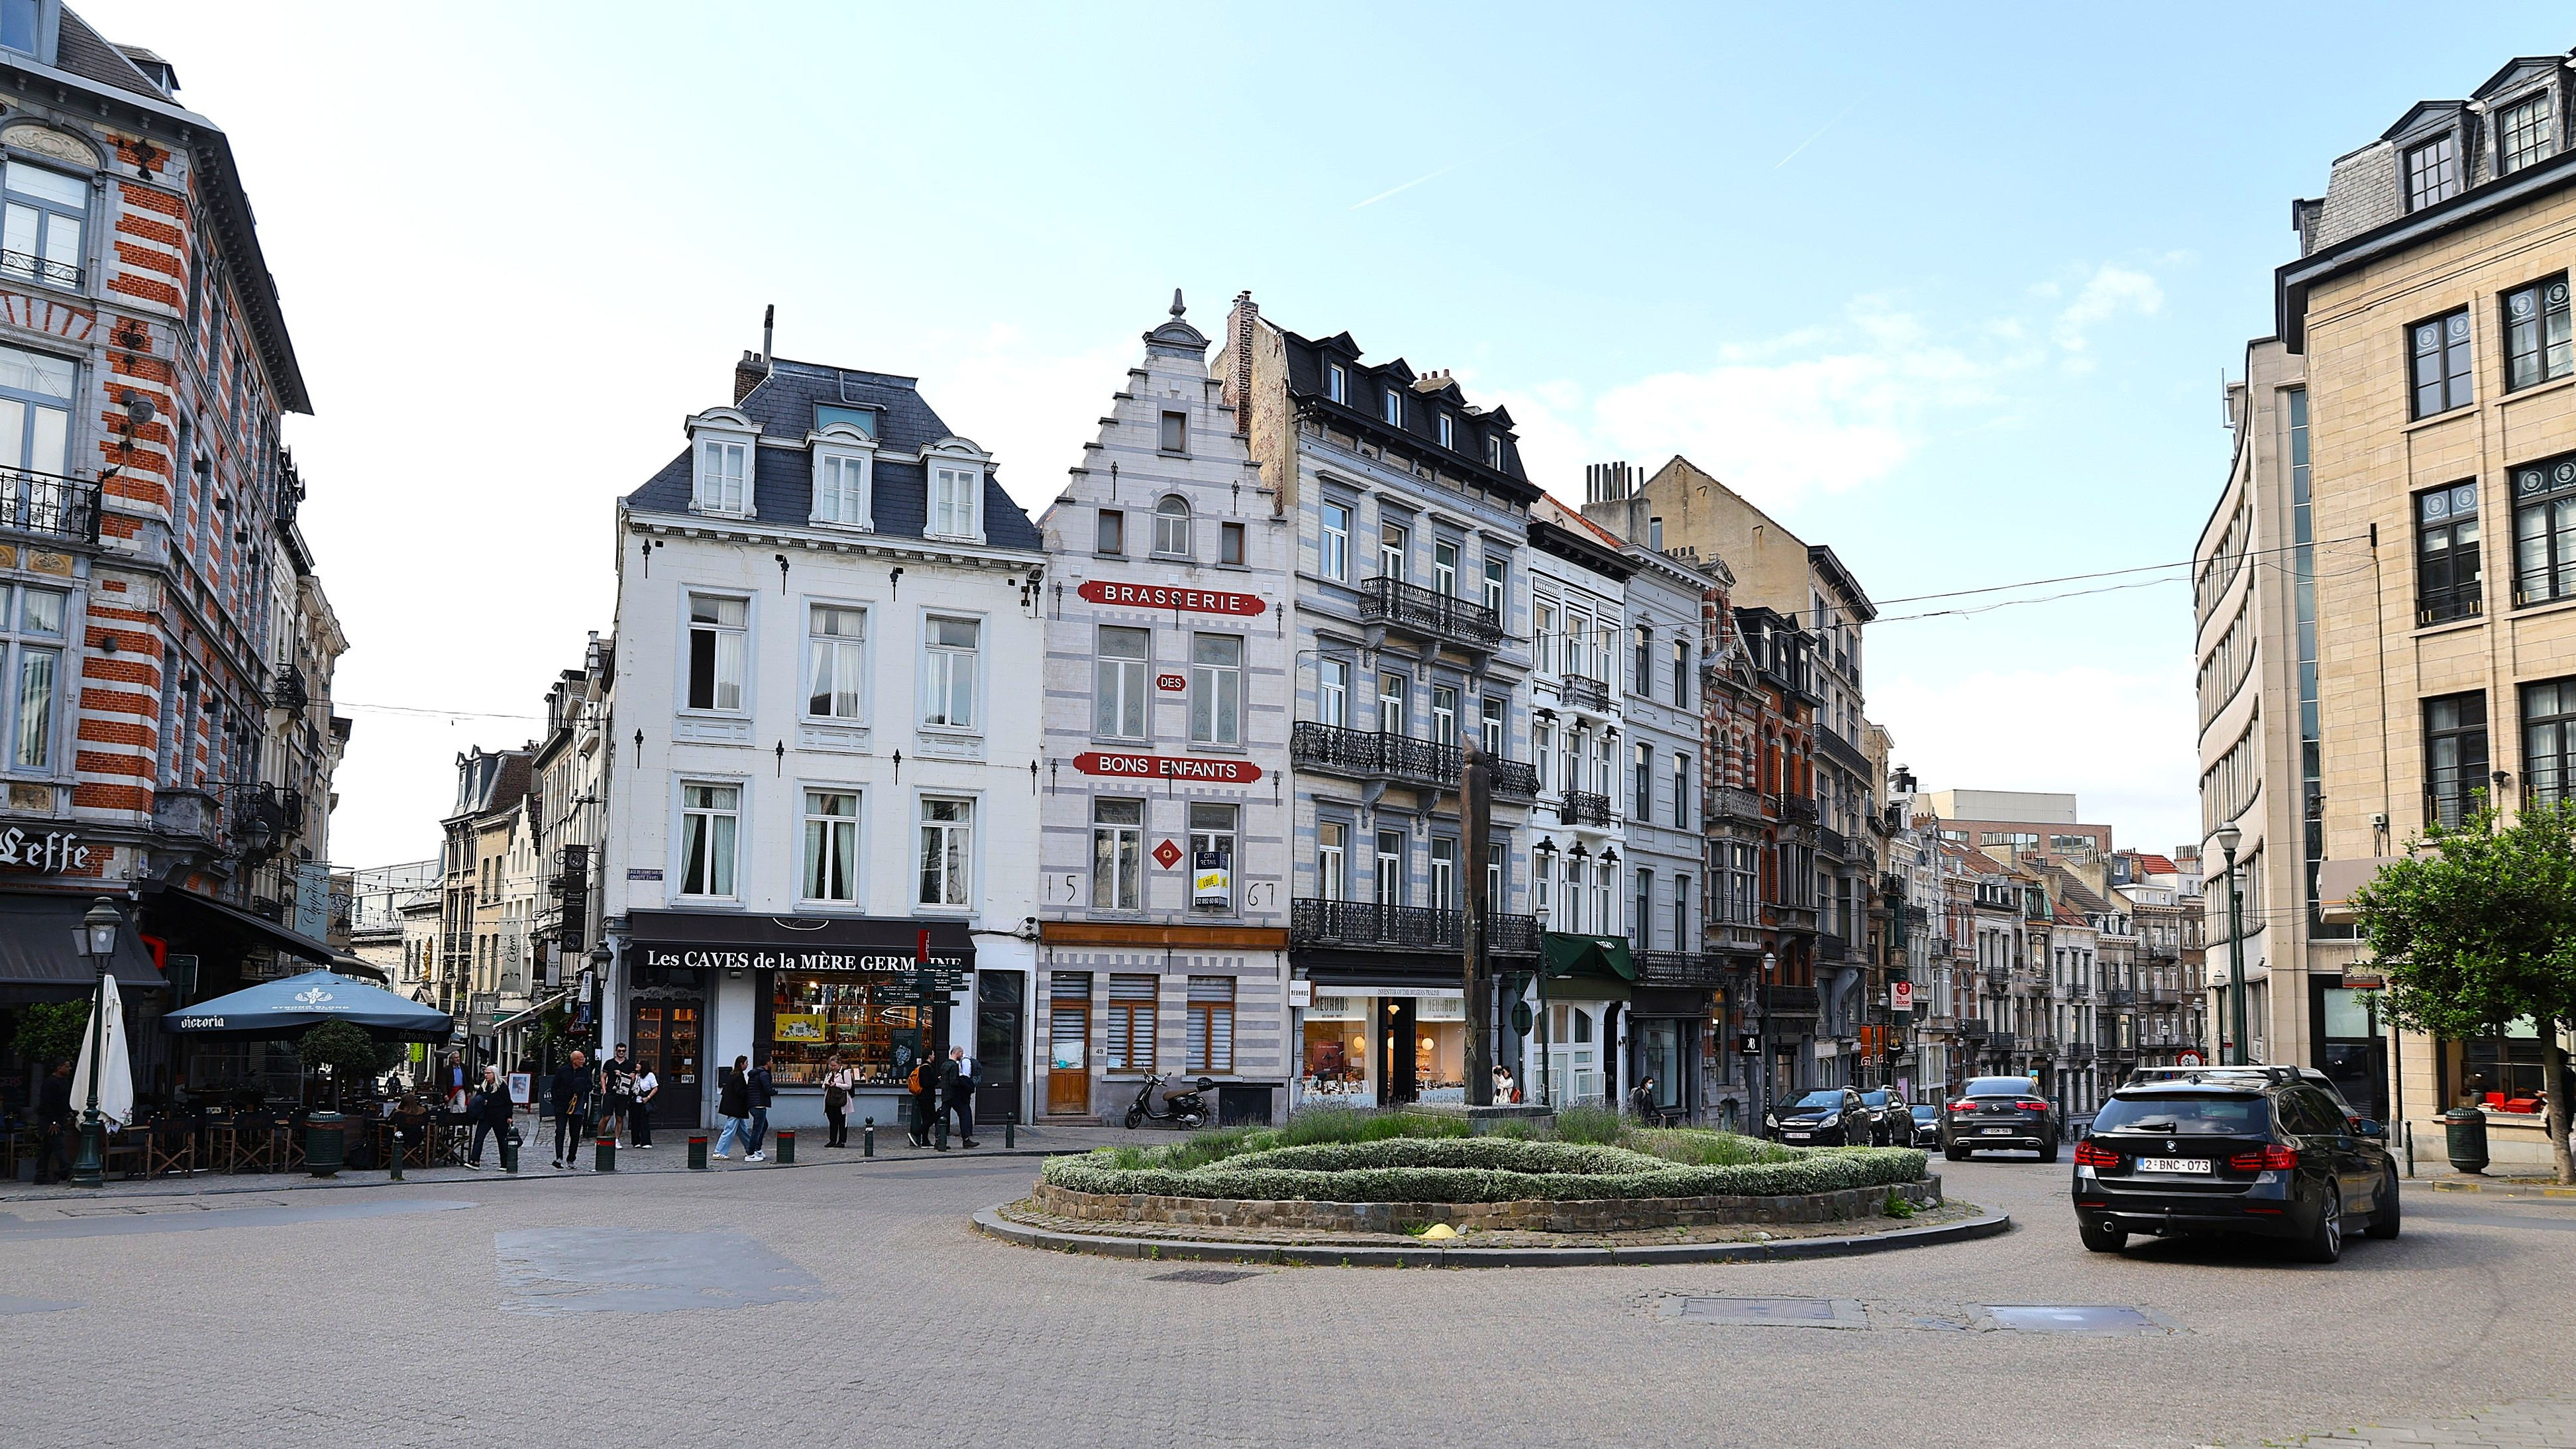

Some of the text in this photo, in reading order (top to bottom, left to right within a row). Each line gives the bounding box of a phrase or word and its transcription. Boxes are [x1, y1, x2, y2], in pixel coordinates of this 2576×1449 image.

[1104, 584, 1241, 611] BRASSERIE
[1161, 677, 1181, 688] DES
[1099, 756, 1237, 778] BONS ENFANTS
[0, 827, 90, 873] Leffe
[647, 951, 962, 972] Les CAVES de la MÈRE GERMINE
[1315, 996, 1349, 1011] NEUHAUS
[1428, 998, 1457, 1012] NEUHAUS
[181, 1015, 225, 1028] victoria
[2145, 1159, 2209, 1171] 2-BNC-073
